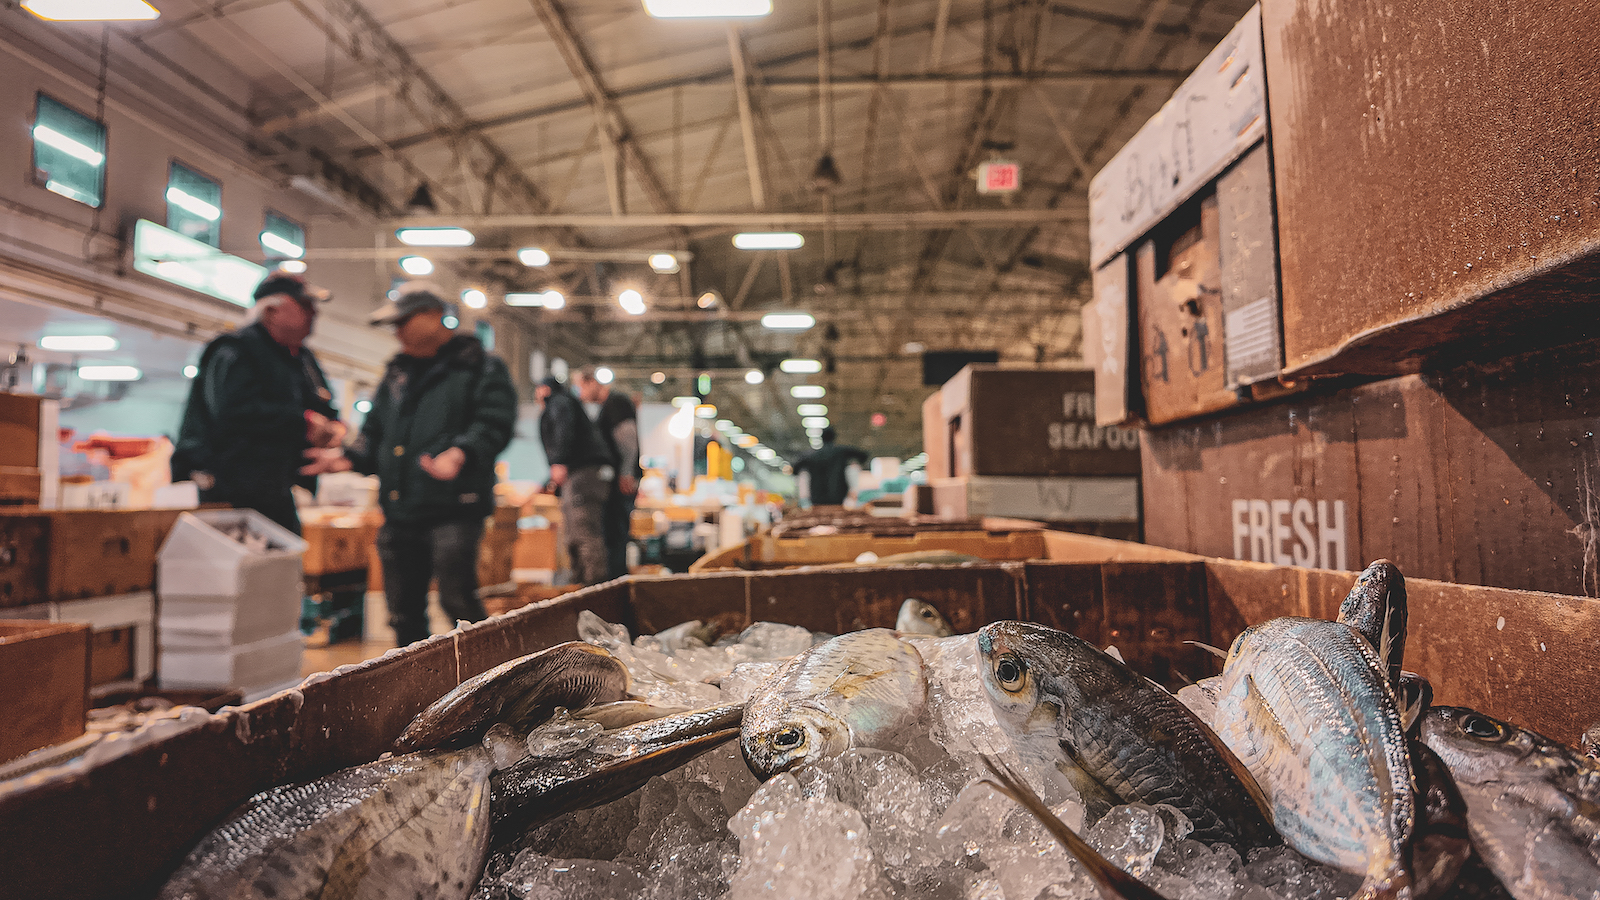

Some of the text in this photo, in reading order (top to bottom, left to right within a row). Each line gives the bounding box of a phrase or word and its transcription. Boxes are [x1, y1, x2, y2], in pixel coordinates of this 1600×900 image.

[1063, 391, 1095, 418] FR
[1048, 422, 1139, 450] SEAFOO
[1231, 498, 1346, 571] FRESH
